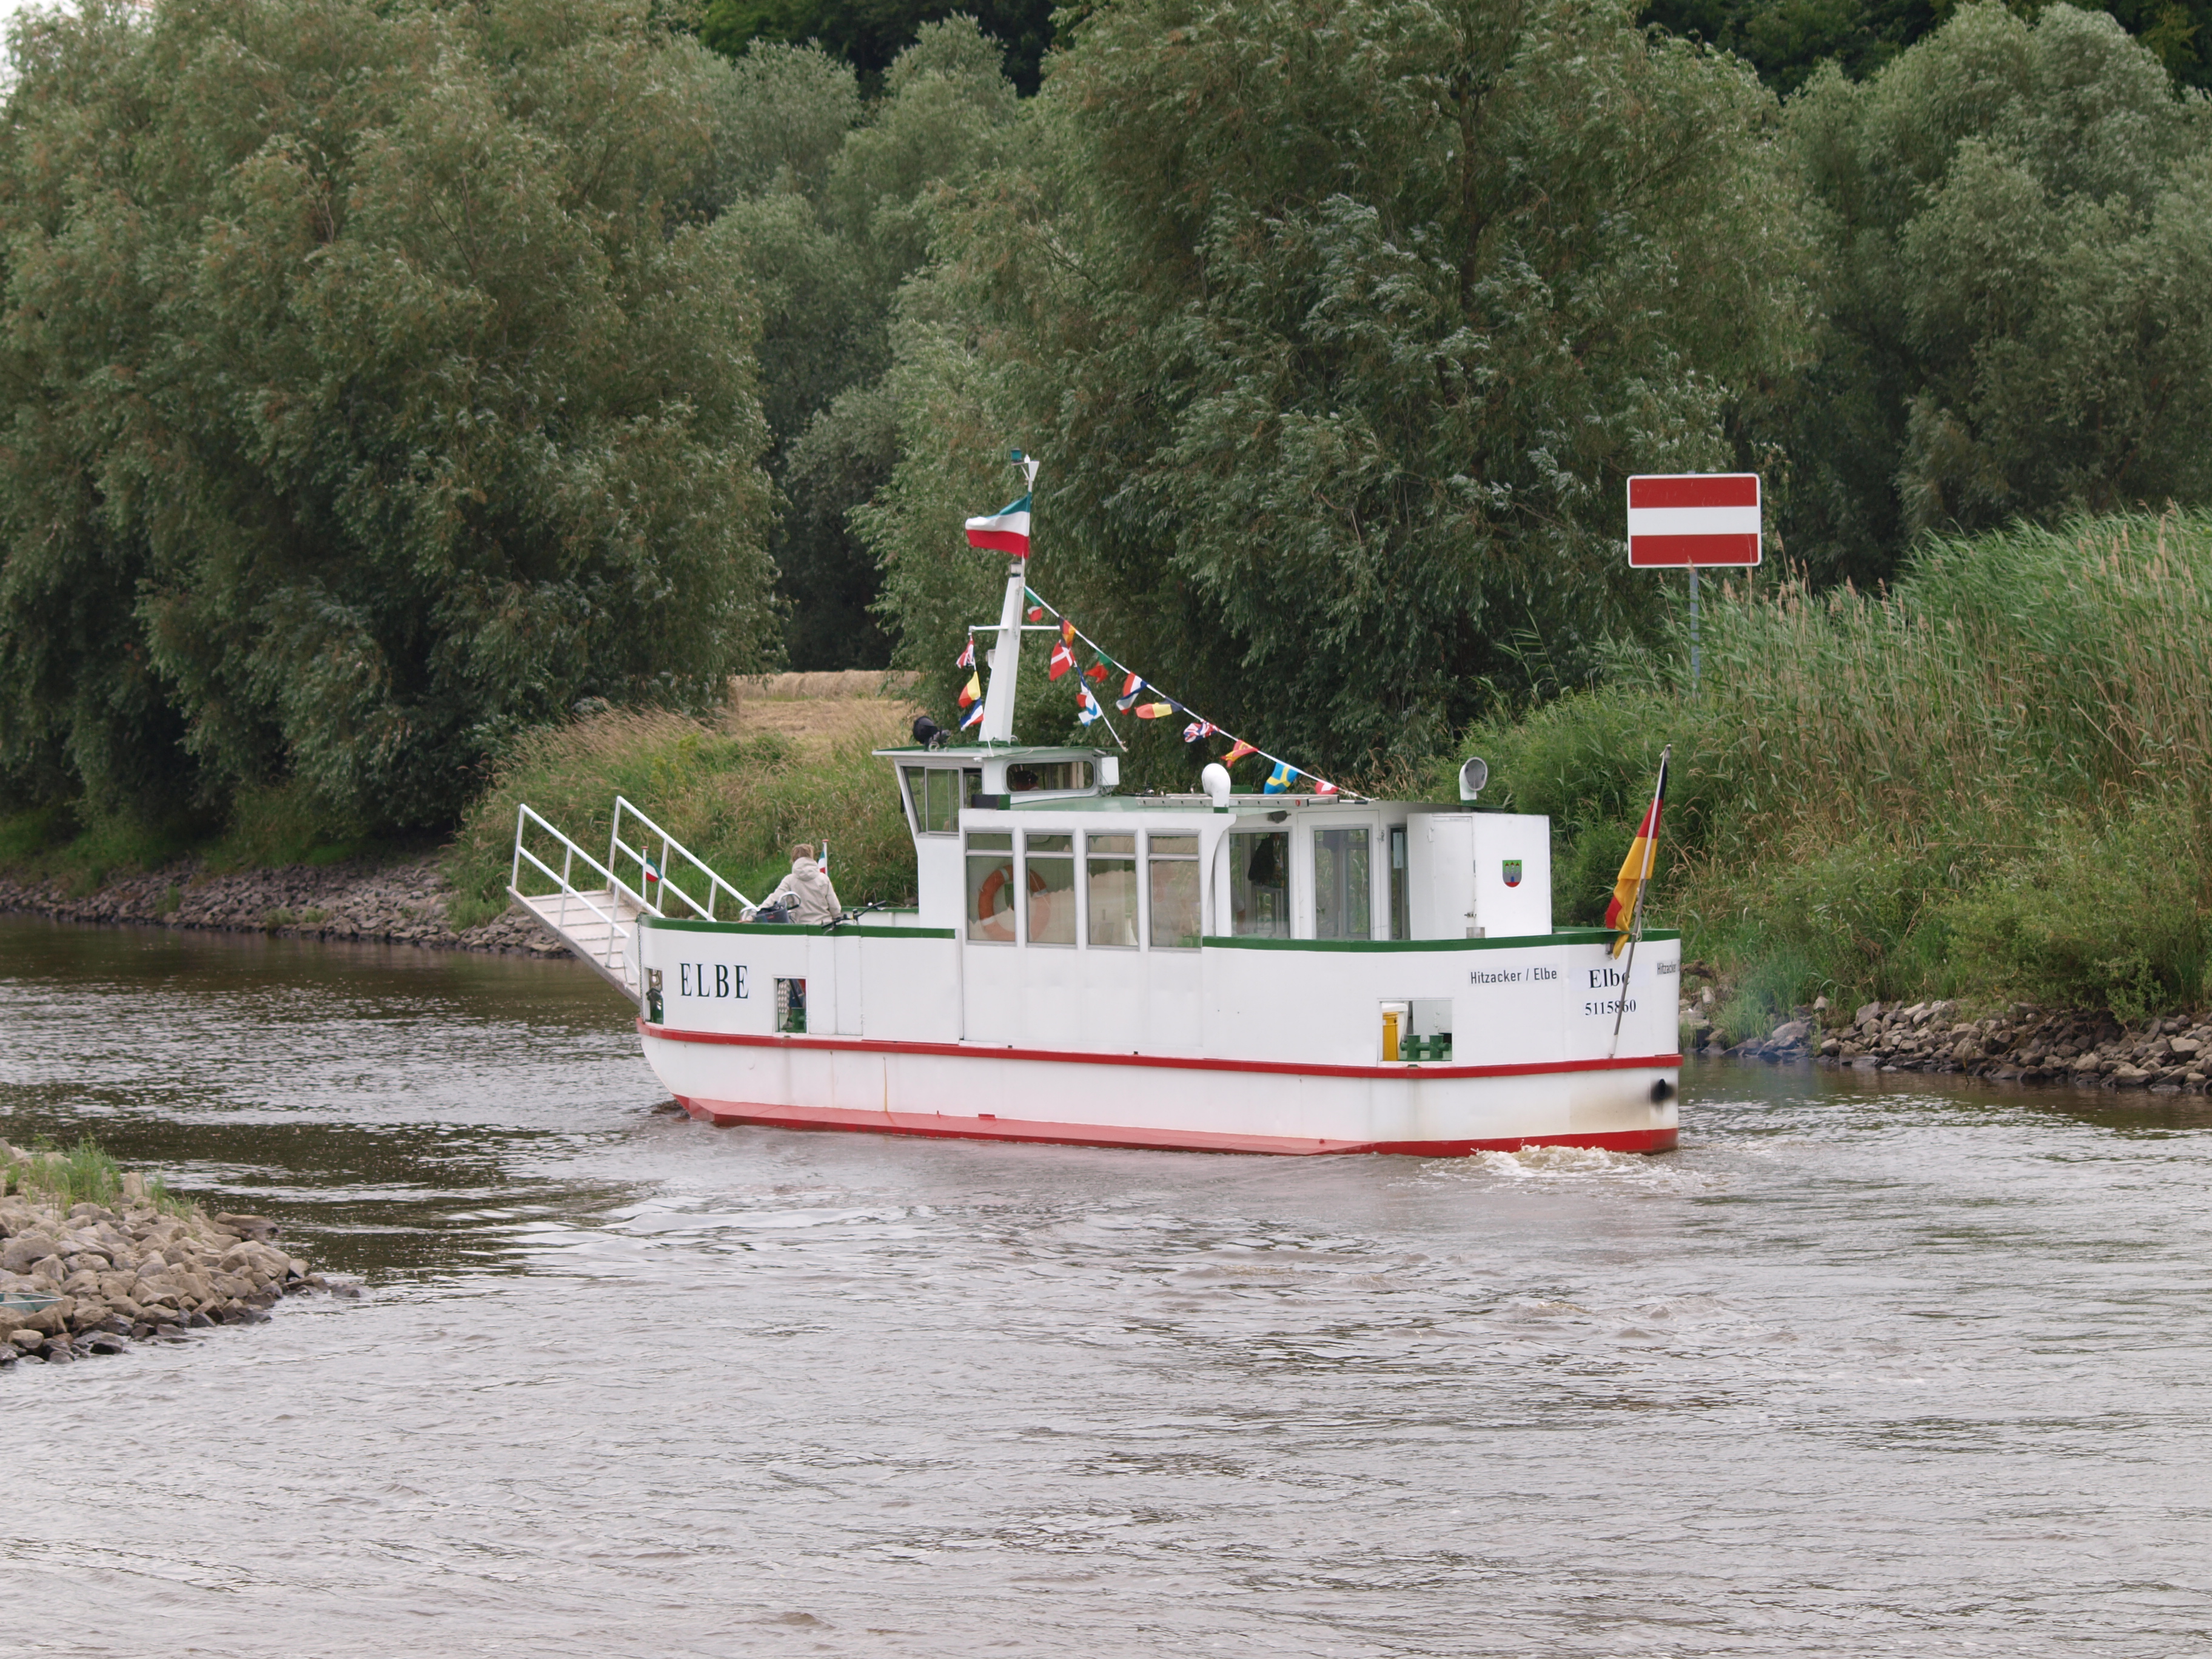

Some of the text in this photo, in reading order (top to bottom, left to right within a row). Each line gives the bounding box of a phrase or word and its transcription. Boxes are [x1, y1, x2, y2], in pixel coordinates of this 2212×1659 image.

[680, 963, 749, 999] ELBE
[1470, 970, 1521, 984] Hitzacker
[1533, 967, 1558, 980] Elbe
[1584, 999, 1637, 1016] 5115860
